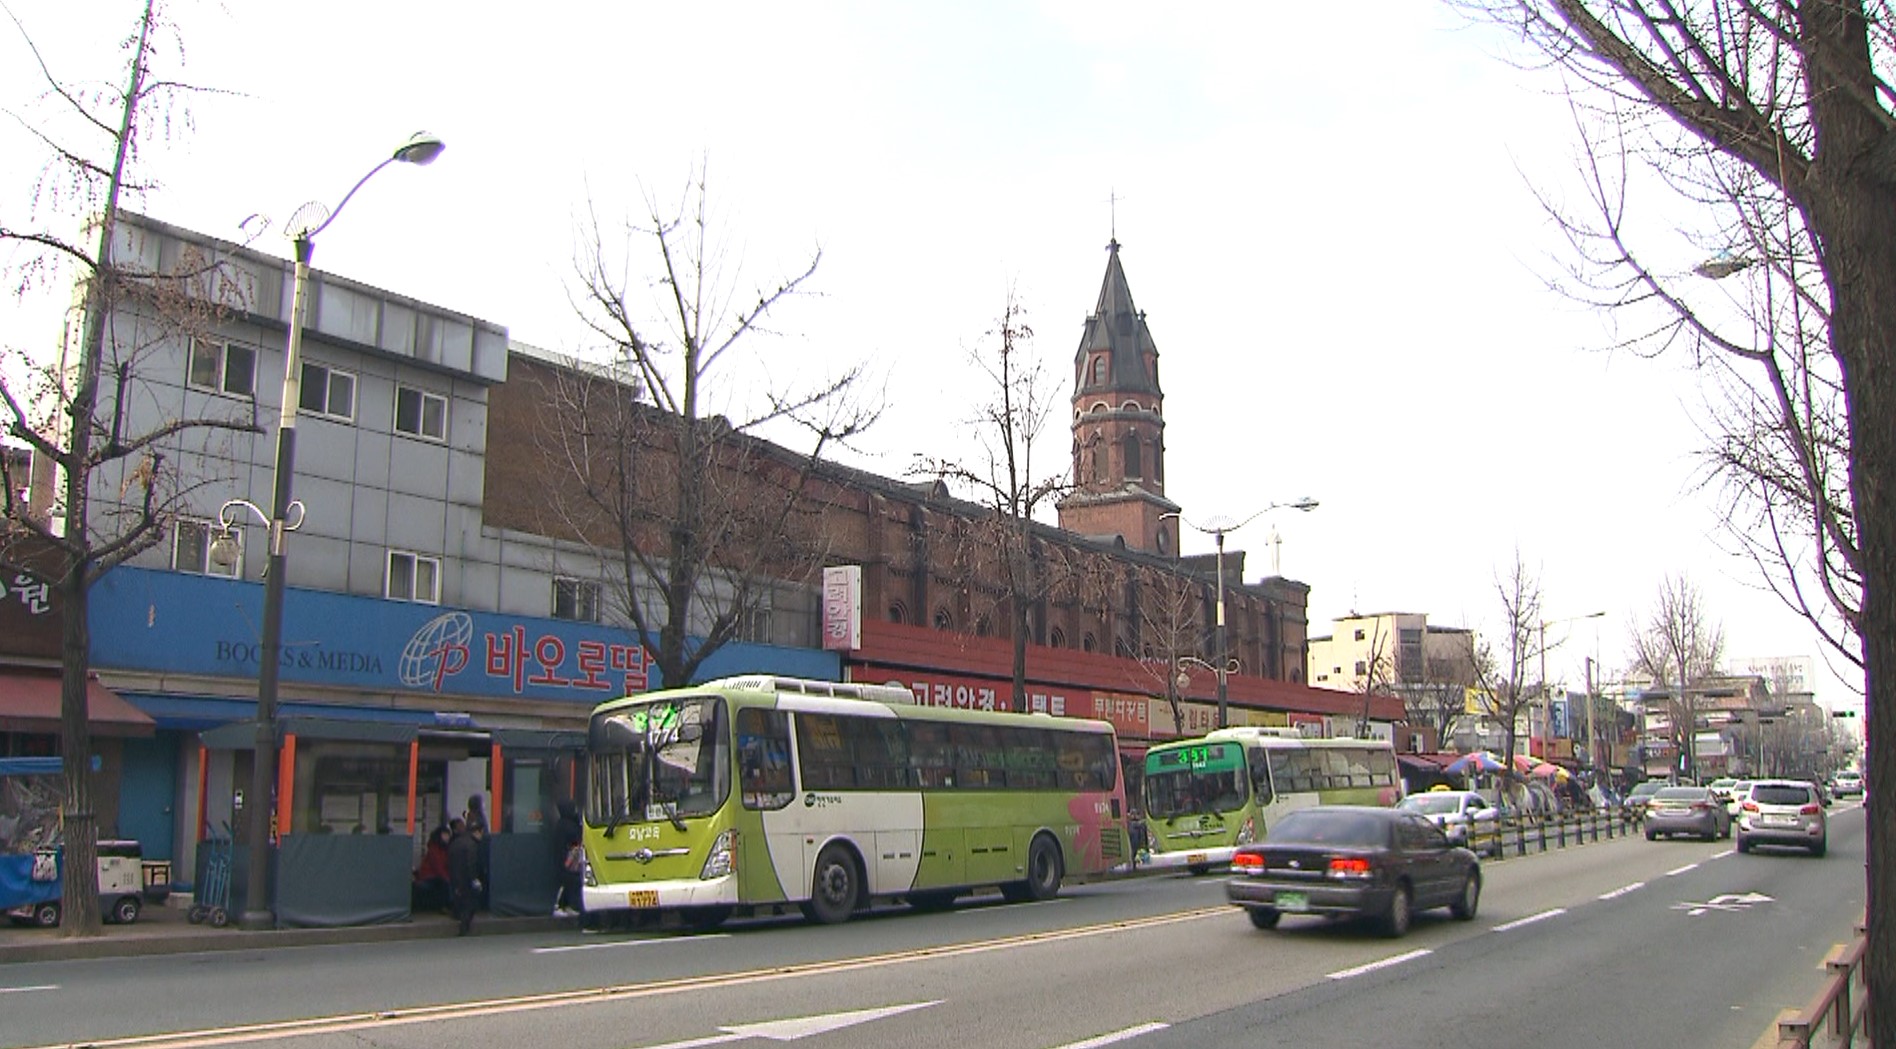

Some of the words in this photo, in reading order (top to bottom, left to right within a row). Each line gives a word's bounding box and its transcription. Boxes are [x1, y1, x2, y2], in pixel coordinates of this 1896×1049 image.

[0, 574, 50, 614] 원
[216, 640, 295, 668] BOOS
[298, 653, 312, 668] &
[317, 656, 383, 674] MEDIA
[485, 625, 656, 697] 바오로딸
[648, 728, 680, 746] 1774
